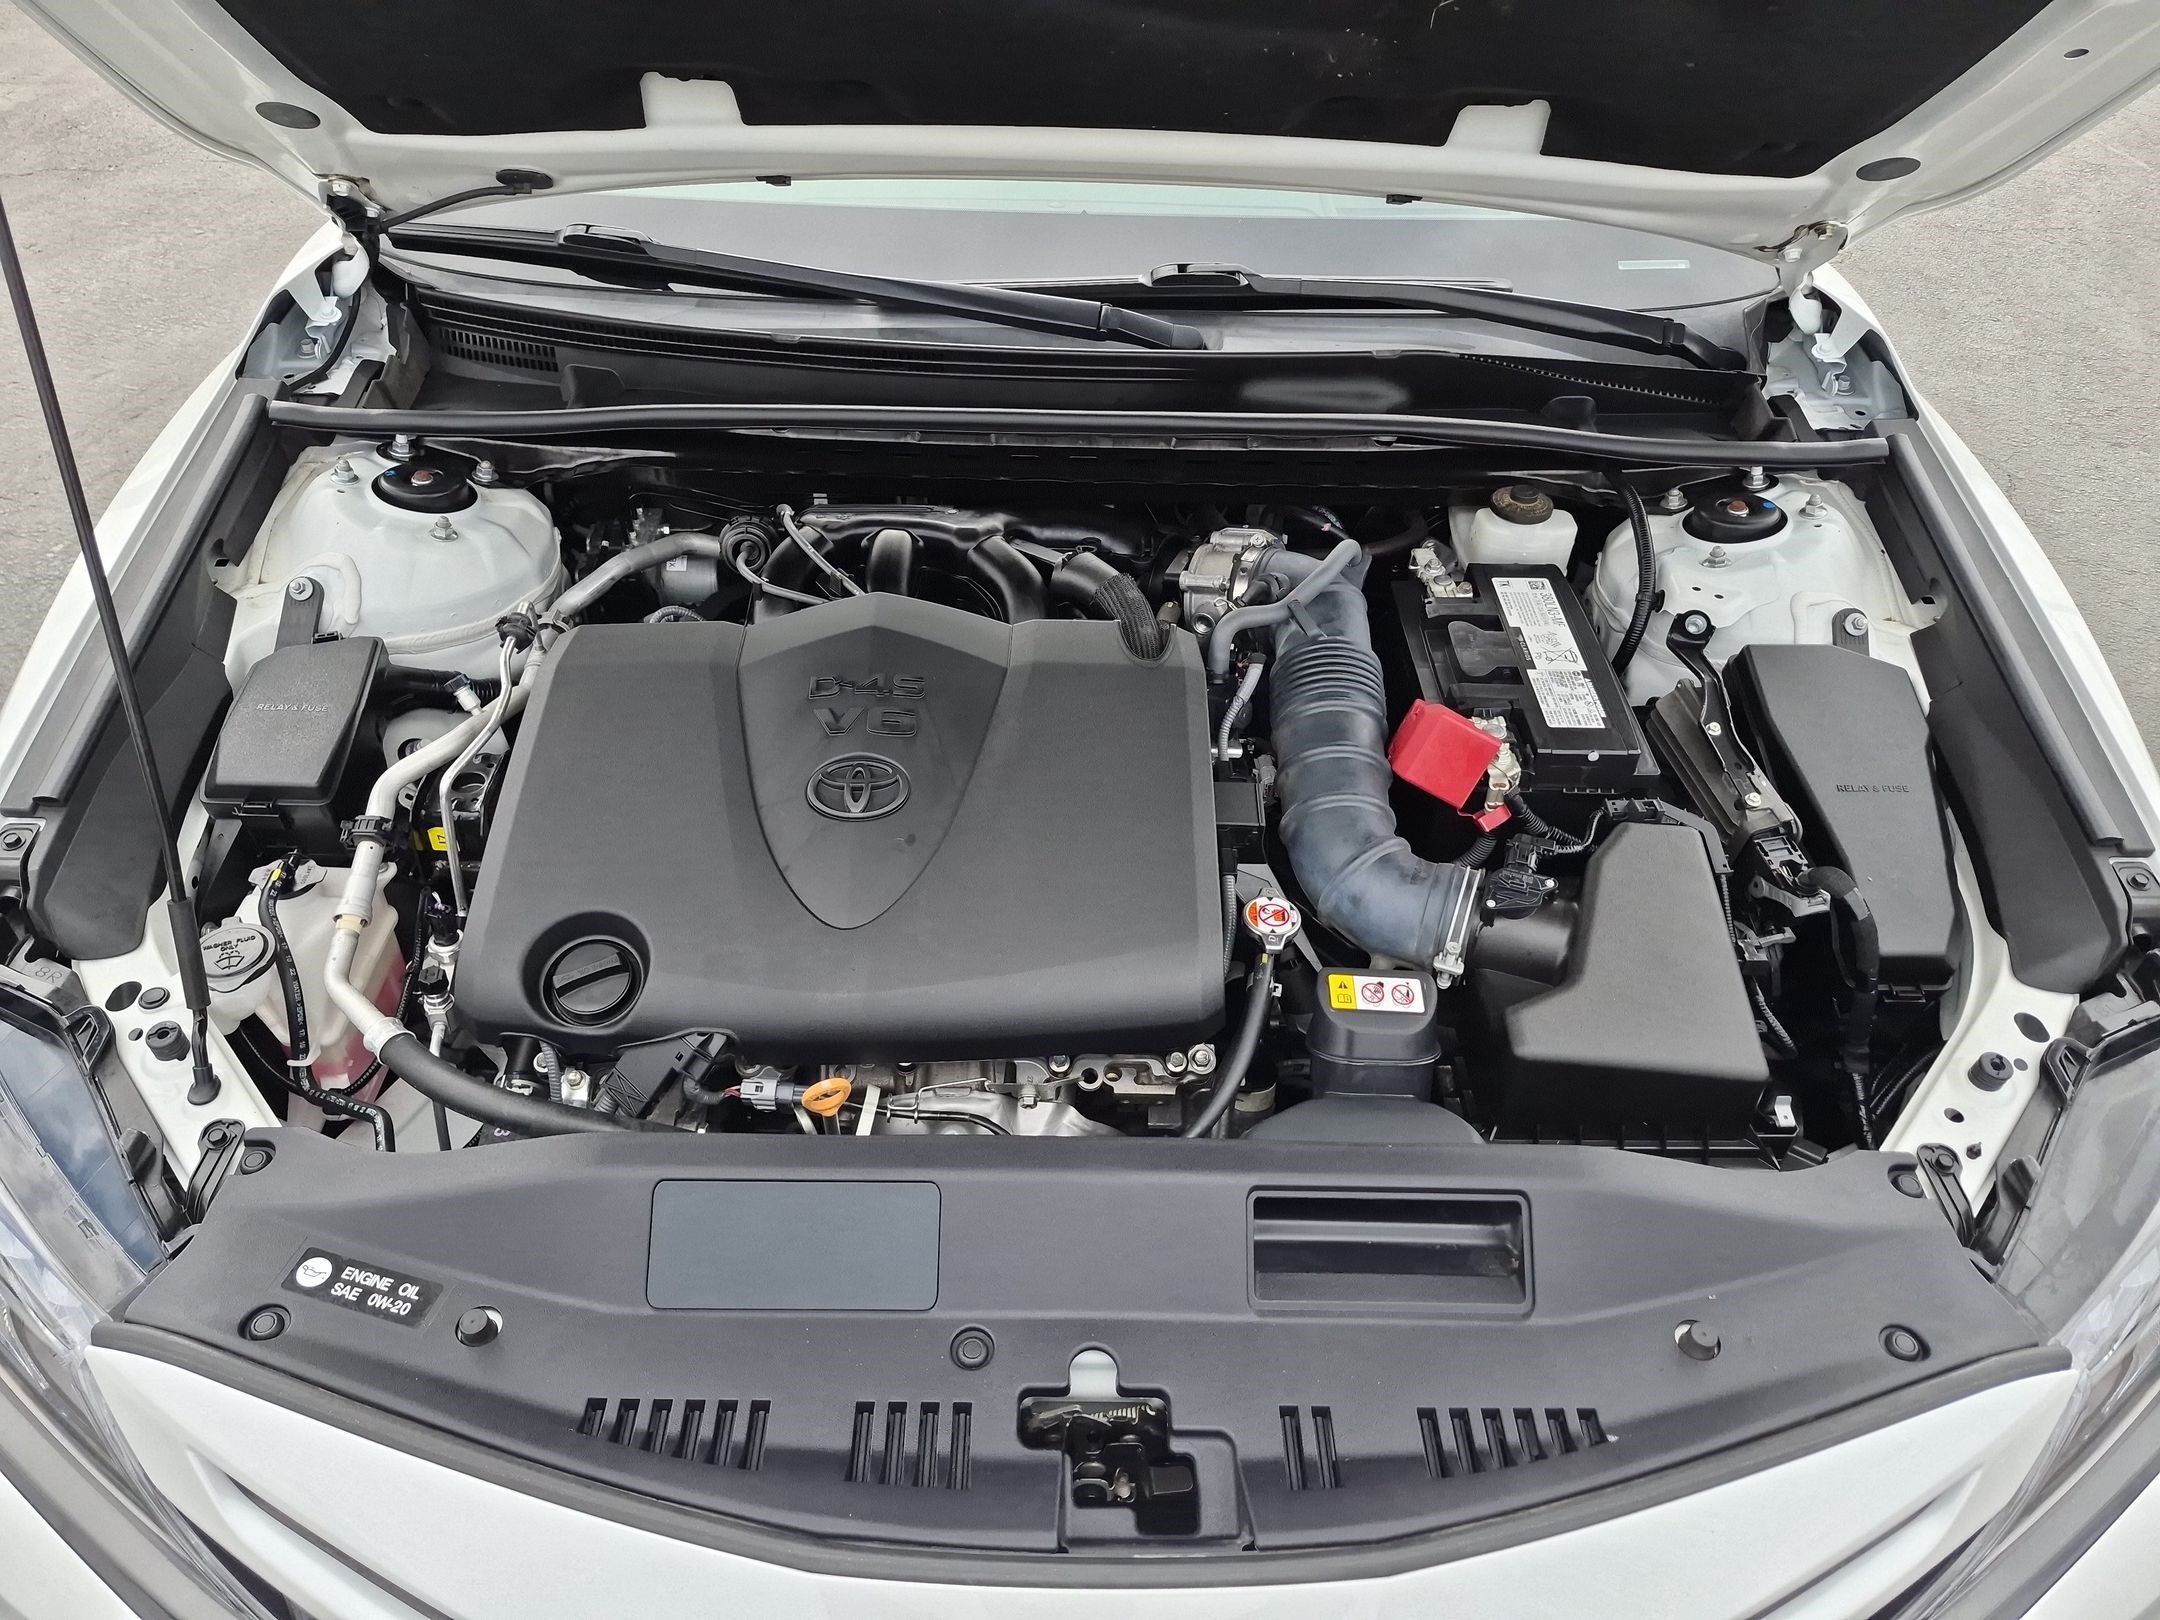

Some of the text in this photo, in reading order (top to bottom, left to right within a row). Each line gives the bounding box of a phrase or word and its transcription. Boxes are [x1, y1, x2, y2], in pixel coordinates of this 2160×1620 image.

[809, 675, 926, 699] D-4S
[256, 703, 292, 712] RELAY
[301, 704, 329, 712] FUSE
[813, 705, 917, 737] V6
[1836, 784, 1870, 793] RELAY
[1881, 784, 1910, 793] FUSE
[203, 935, 256, 951] WASHER FLUID
[220, 944, 238, 952] ONLY
[35, 966, 63, 984] 8R
[289, 967, 297, 977] 22
[292, 980, 302, 1002] WATER
[340, 1265, 421, 1301] ENGINE OIL
[330, 1282, 412, 1316] SAE 0W-20
